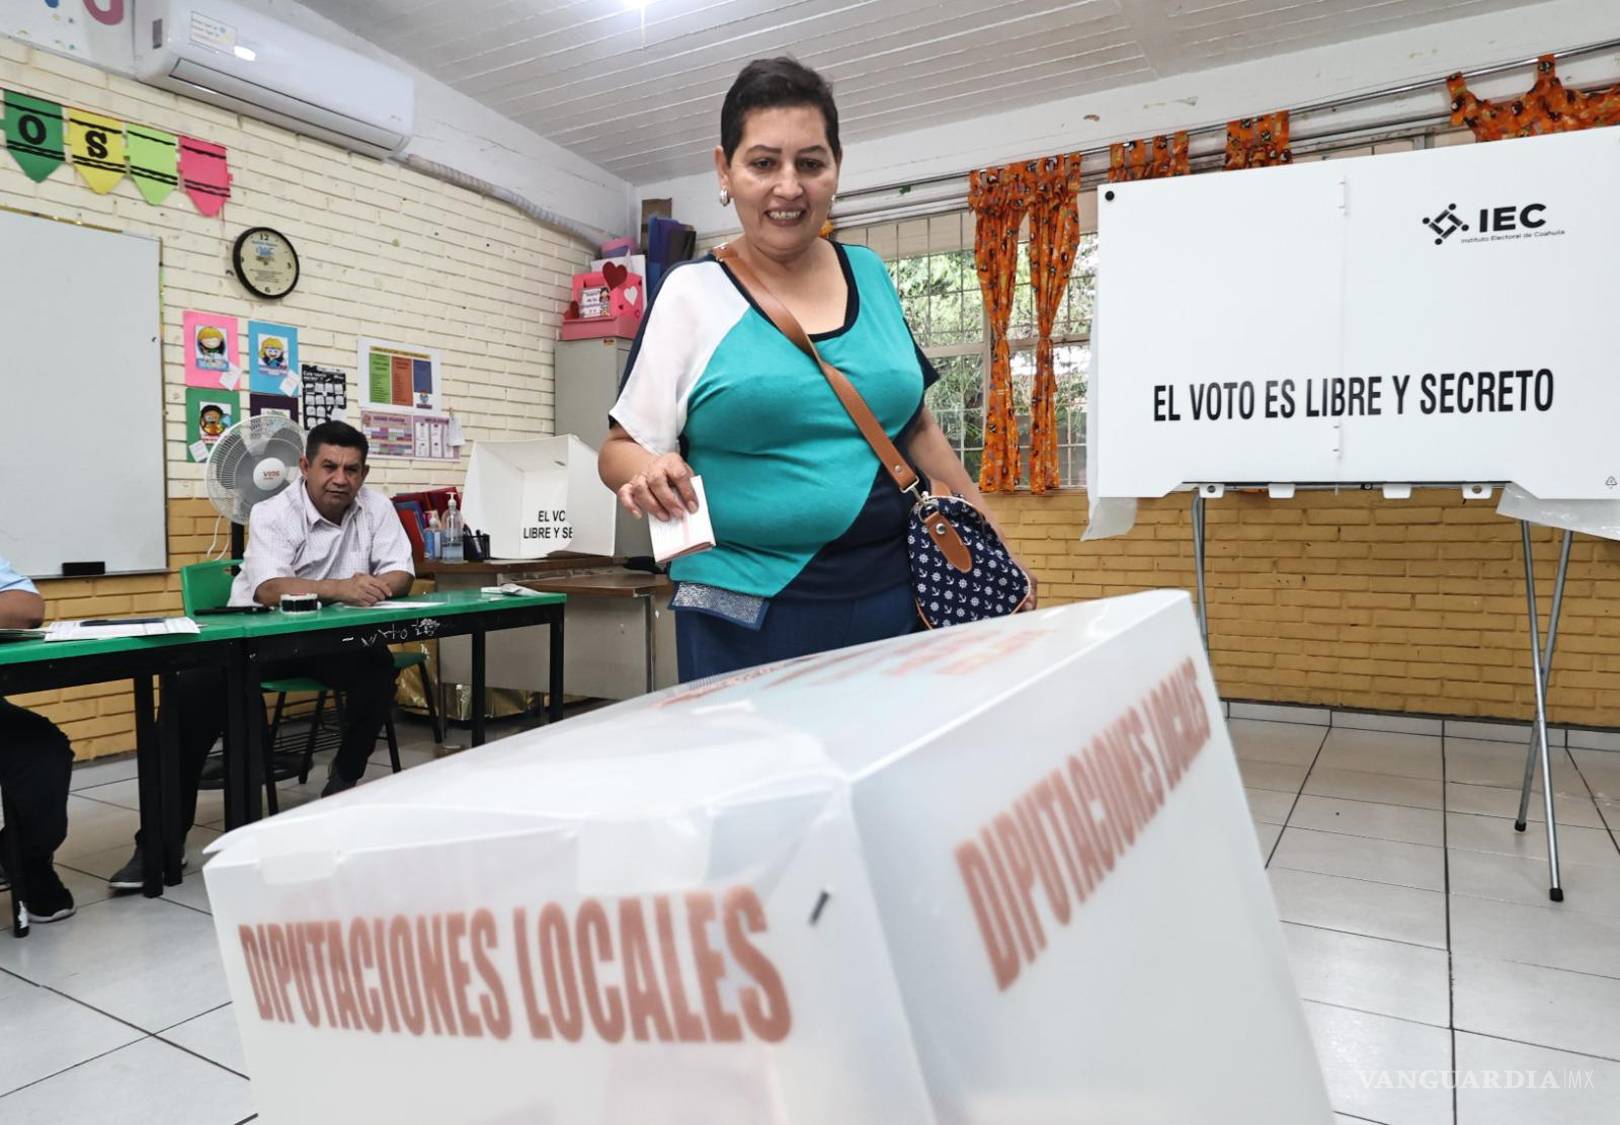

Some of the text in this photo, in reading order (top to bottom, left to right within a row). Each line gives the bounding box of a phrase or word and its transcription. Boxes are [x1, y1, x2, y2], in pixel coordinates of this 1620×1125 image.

[1479, 203, 1547, 233] IEC
[260, 232, 270, 241] 12
[1491, 233, 1521, 241] Electoral
[1534, 229, 1566, 238] Coahuila
[1153, 368, 1555, 422] EL VOTO ES LIBRE Y SECRETO
[538, 510, 550, 522] EL
[523, 527, 551, 539] LIBRE
[553, 527, 560, 539] Y
[953, 704, 1167, 993] DIPUTACIONES
[237, 884, 793, 1044] DIPUTACIONES LOCALES
